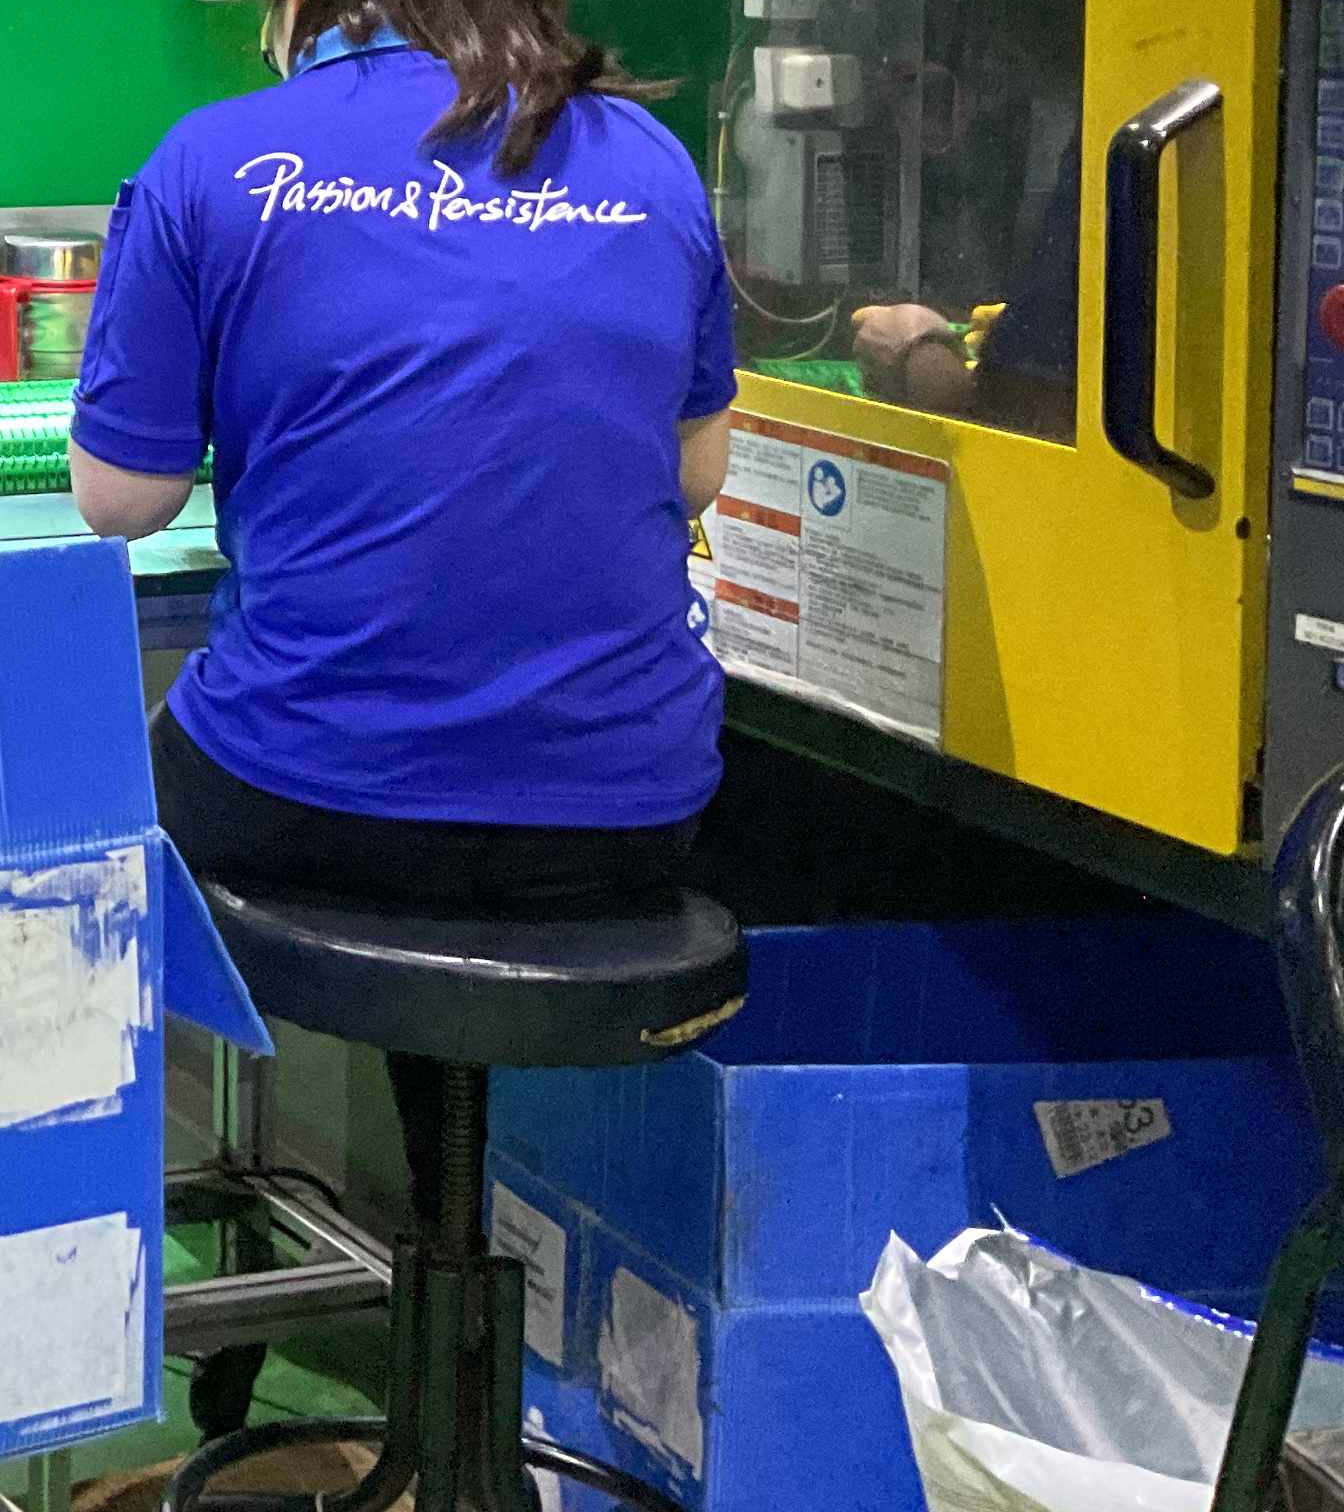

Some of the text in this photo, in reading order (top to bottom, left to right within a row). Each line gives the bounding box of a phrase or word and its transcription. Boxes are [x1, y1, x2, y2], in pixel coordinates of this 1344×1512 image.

[233, 151, 648, 233] Passion & Persistence
